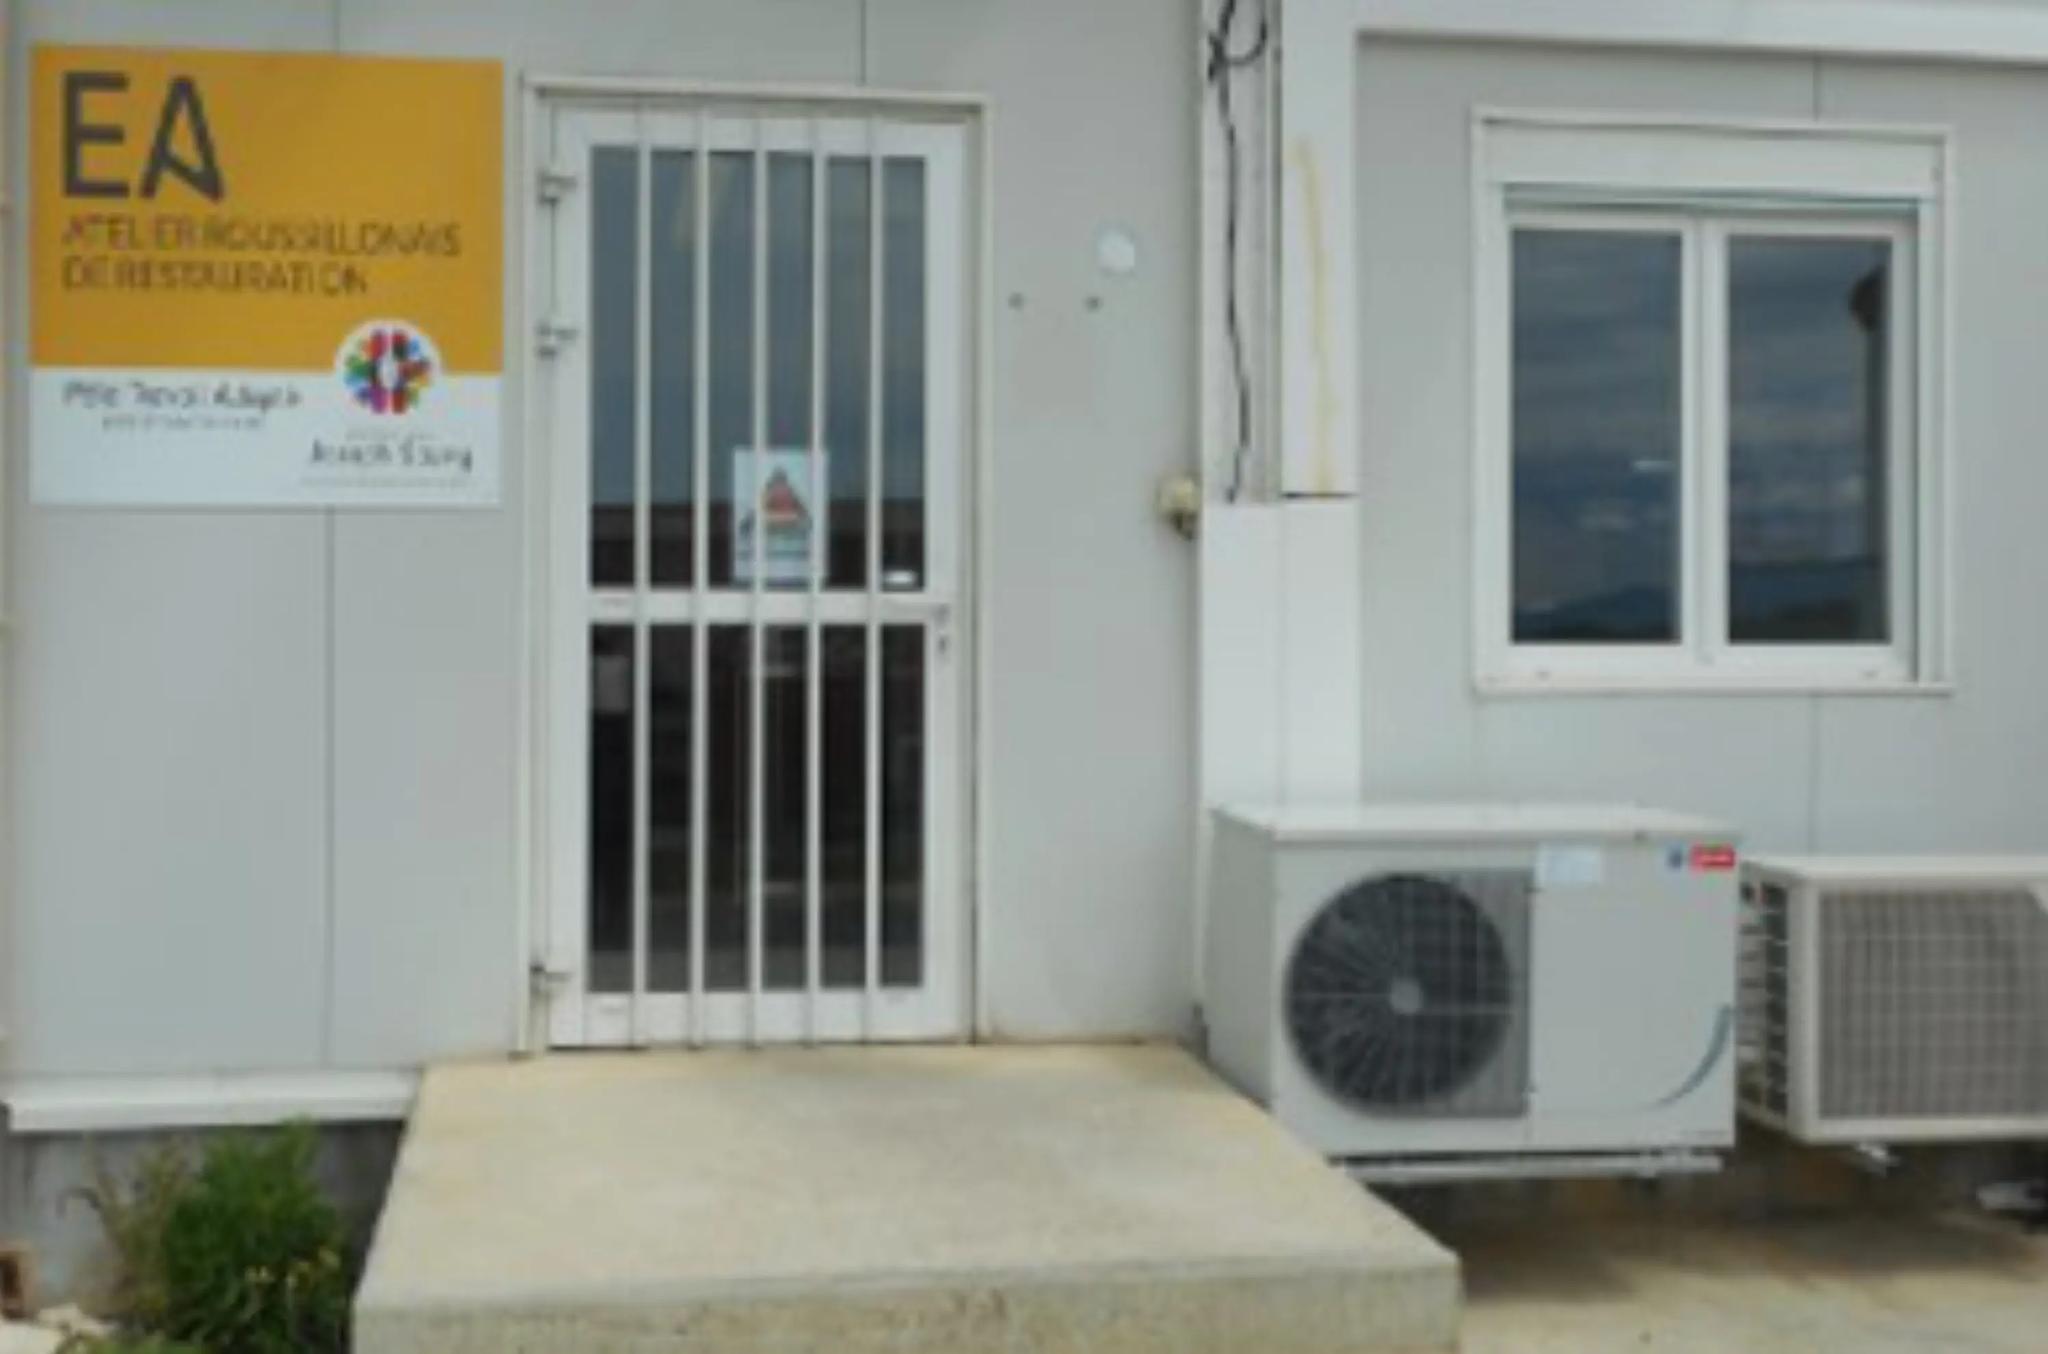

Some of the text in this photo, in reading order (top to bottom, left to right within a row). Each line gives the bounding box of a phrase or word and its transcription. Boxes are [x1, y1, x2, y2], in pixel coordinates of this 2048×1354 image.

[62, 70, 225, 202] EA
[61, 213, 195, 251] ATELIER
[62, 254, 368, 296] DE RESTAURATION
